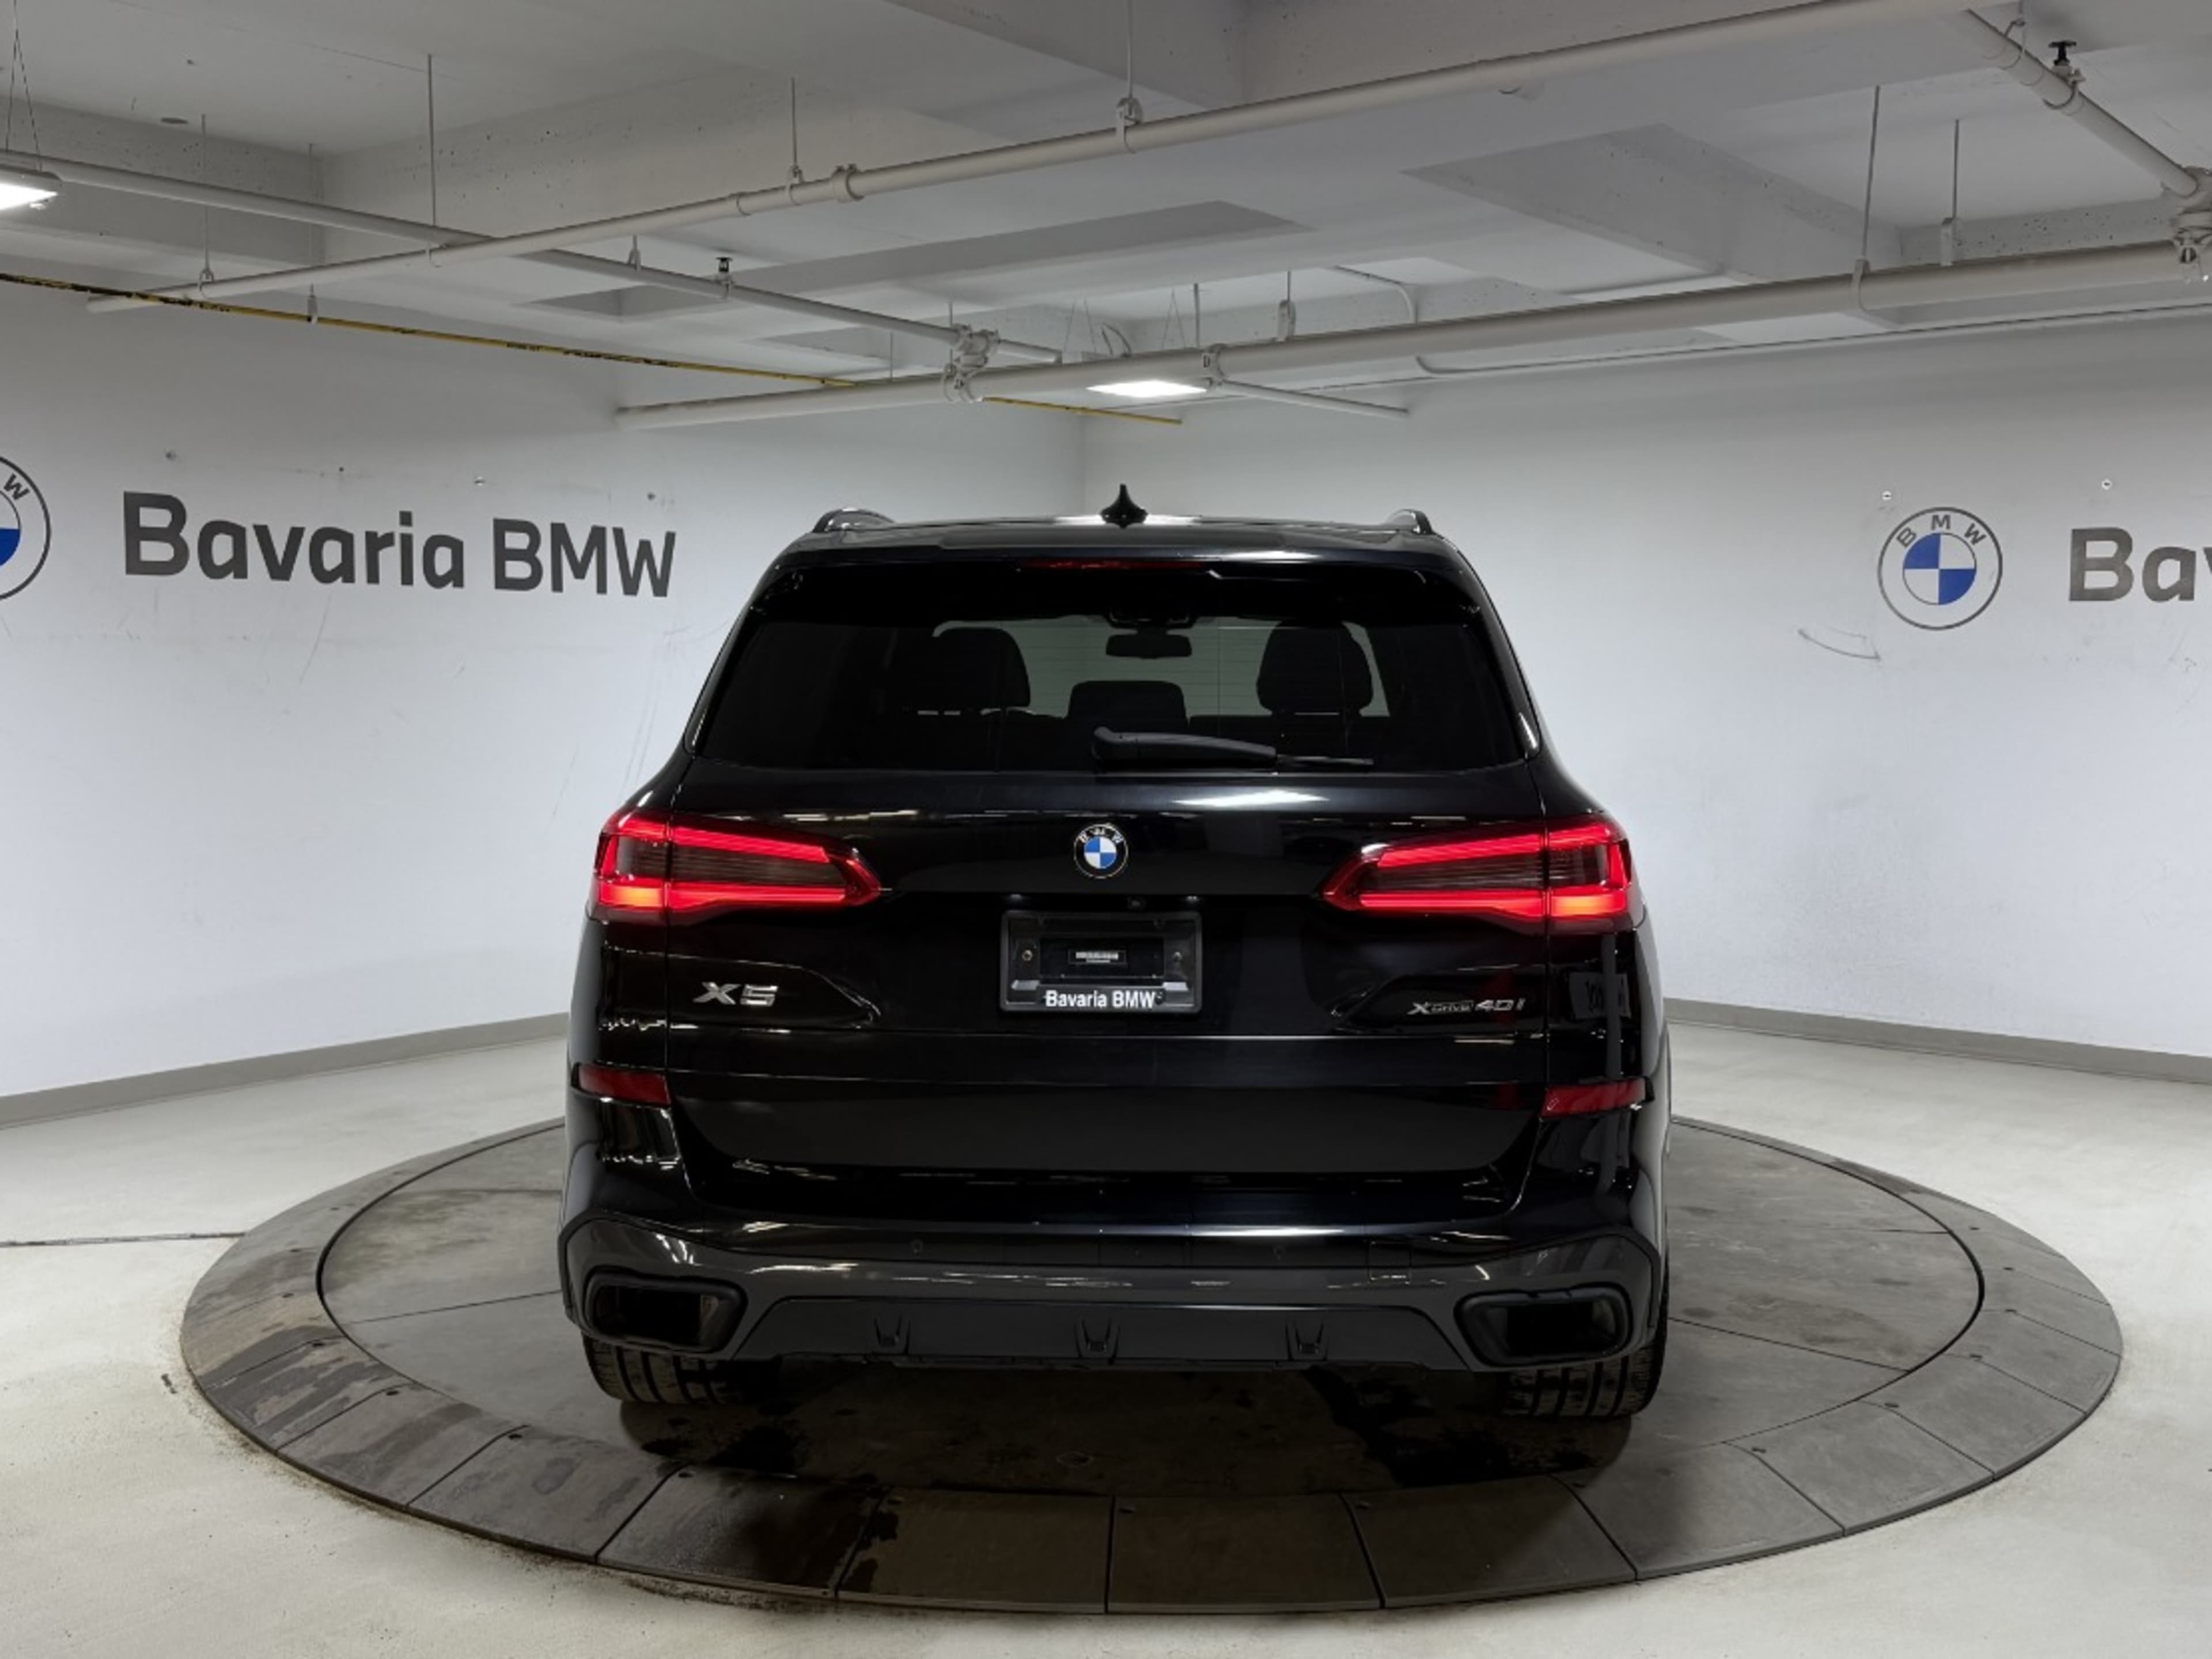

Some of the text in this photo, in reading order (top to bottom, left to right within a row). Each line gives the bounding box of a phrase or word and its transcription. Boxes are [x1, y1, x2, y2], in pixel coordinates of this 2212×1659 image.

[124, 491, 676, 597] Bavaria BMW
[1896, 514, 1987, 548] BMW
[693, 982, 779, 1007] X5
[1046, 990, 1156, 1009] Bavaria BMW
